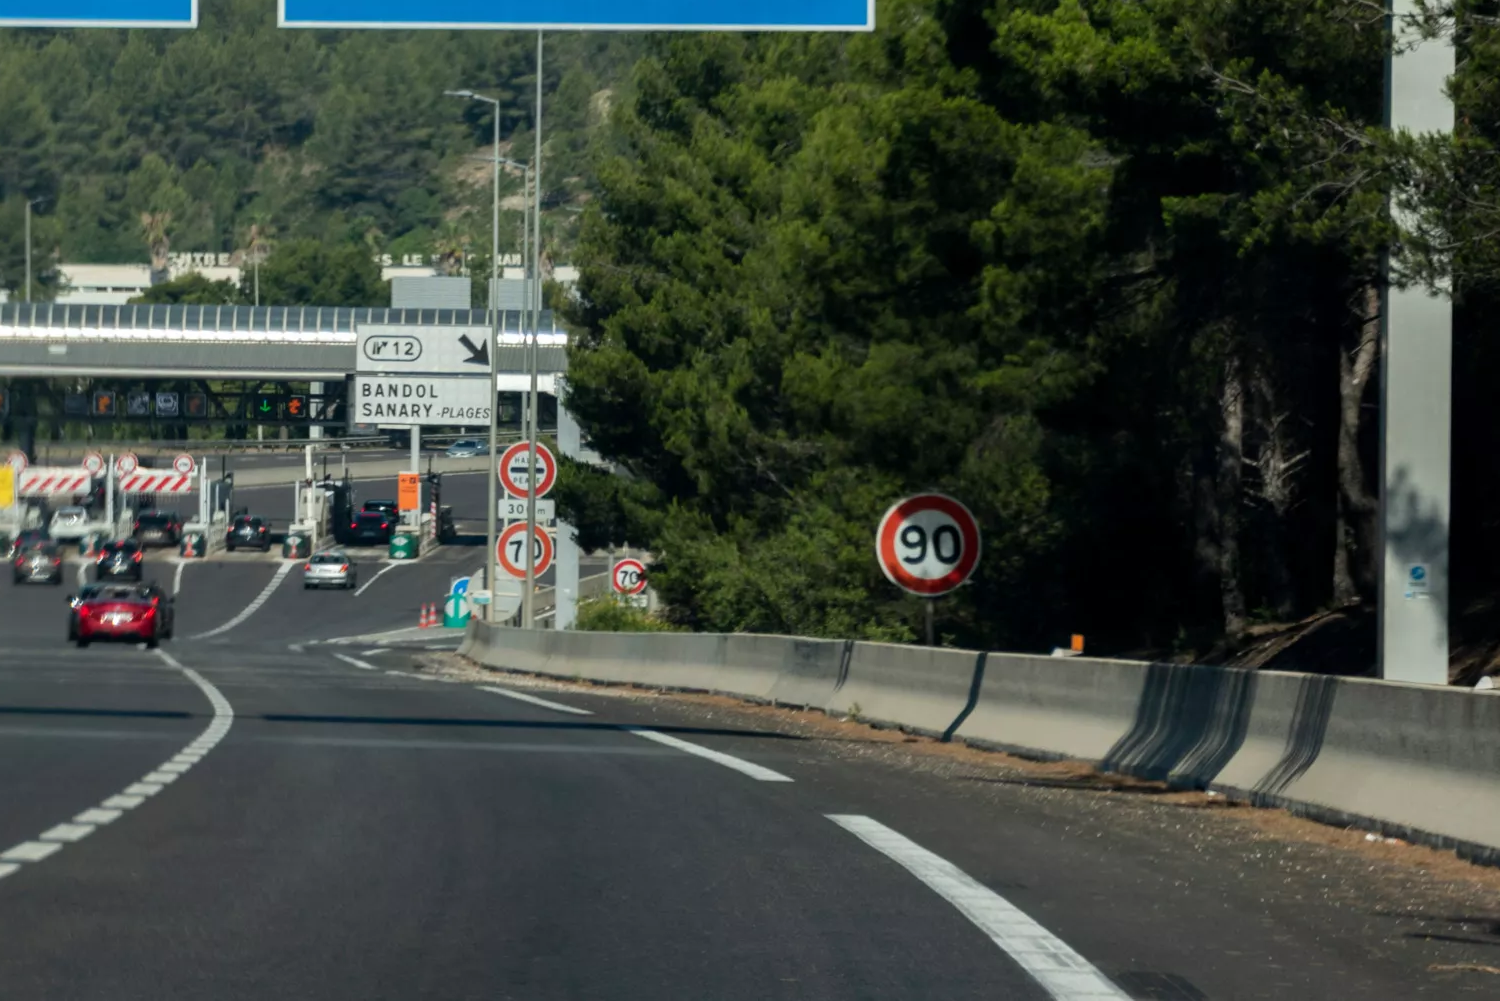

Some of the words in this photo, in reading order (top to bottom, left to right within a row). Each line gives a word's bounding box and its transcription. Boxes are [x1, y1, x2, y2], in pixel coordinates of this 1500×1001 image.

[393, 341, 414, 356] 12
[362, 383, 439, 398] BANDOL
[362, 403, 433, 417] SANARY
[508, 503, 532, 515] 30
[901, 525, 961, 565] 90
[620, 570, 640, 585] 70
